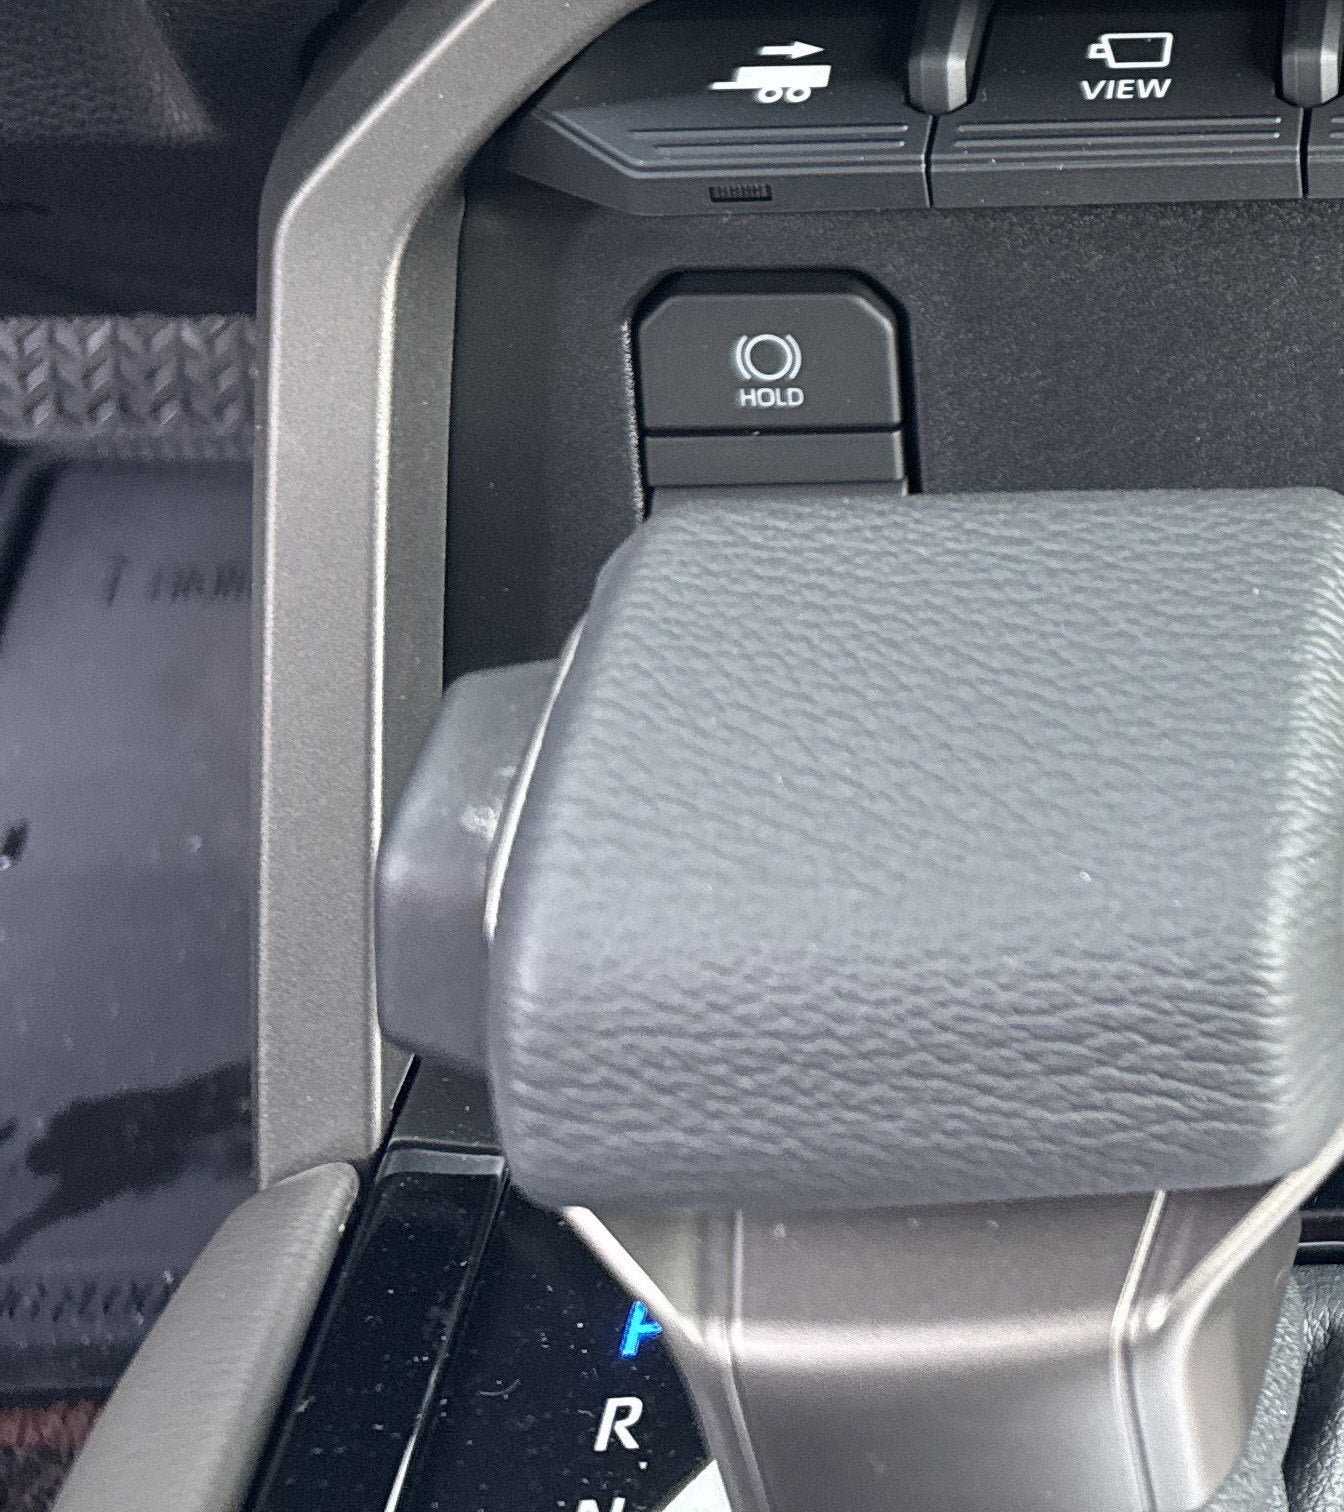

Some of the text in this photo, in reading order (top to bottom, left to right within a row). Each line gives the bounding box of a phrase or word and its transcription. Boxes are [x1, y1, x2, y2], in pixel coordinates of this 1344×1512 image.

[1080, 78, 1173, 100] VIEW
[740, 387, 805, 407] HOLD
[594, 1396, 643, 1452] R
